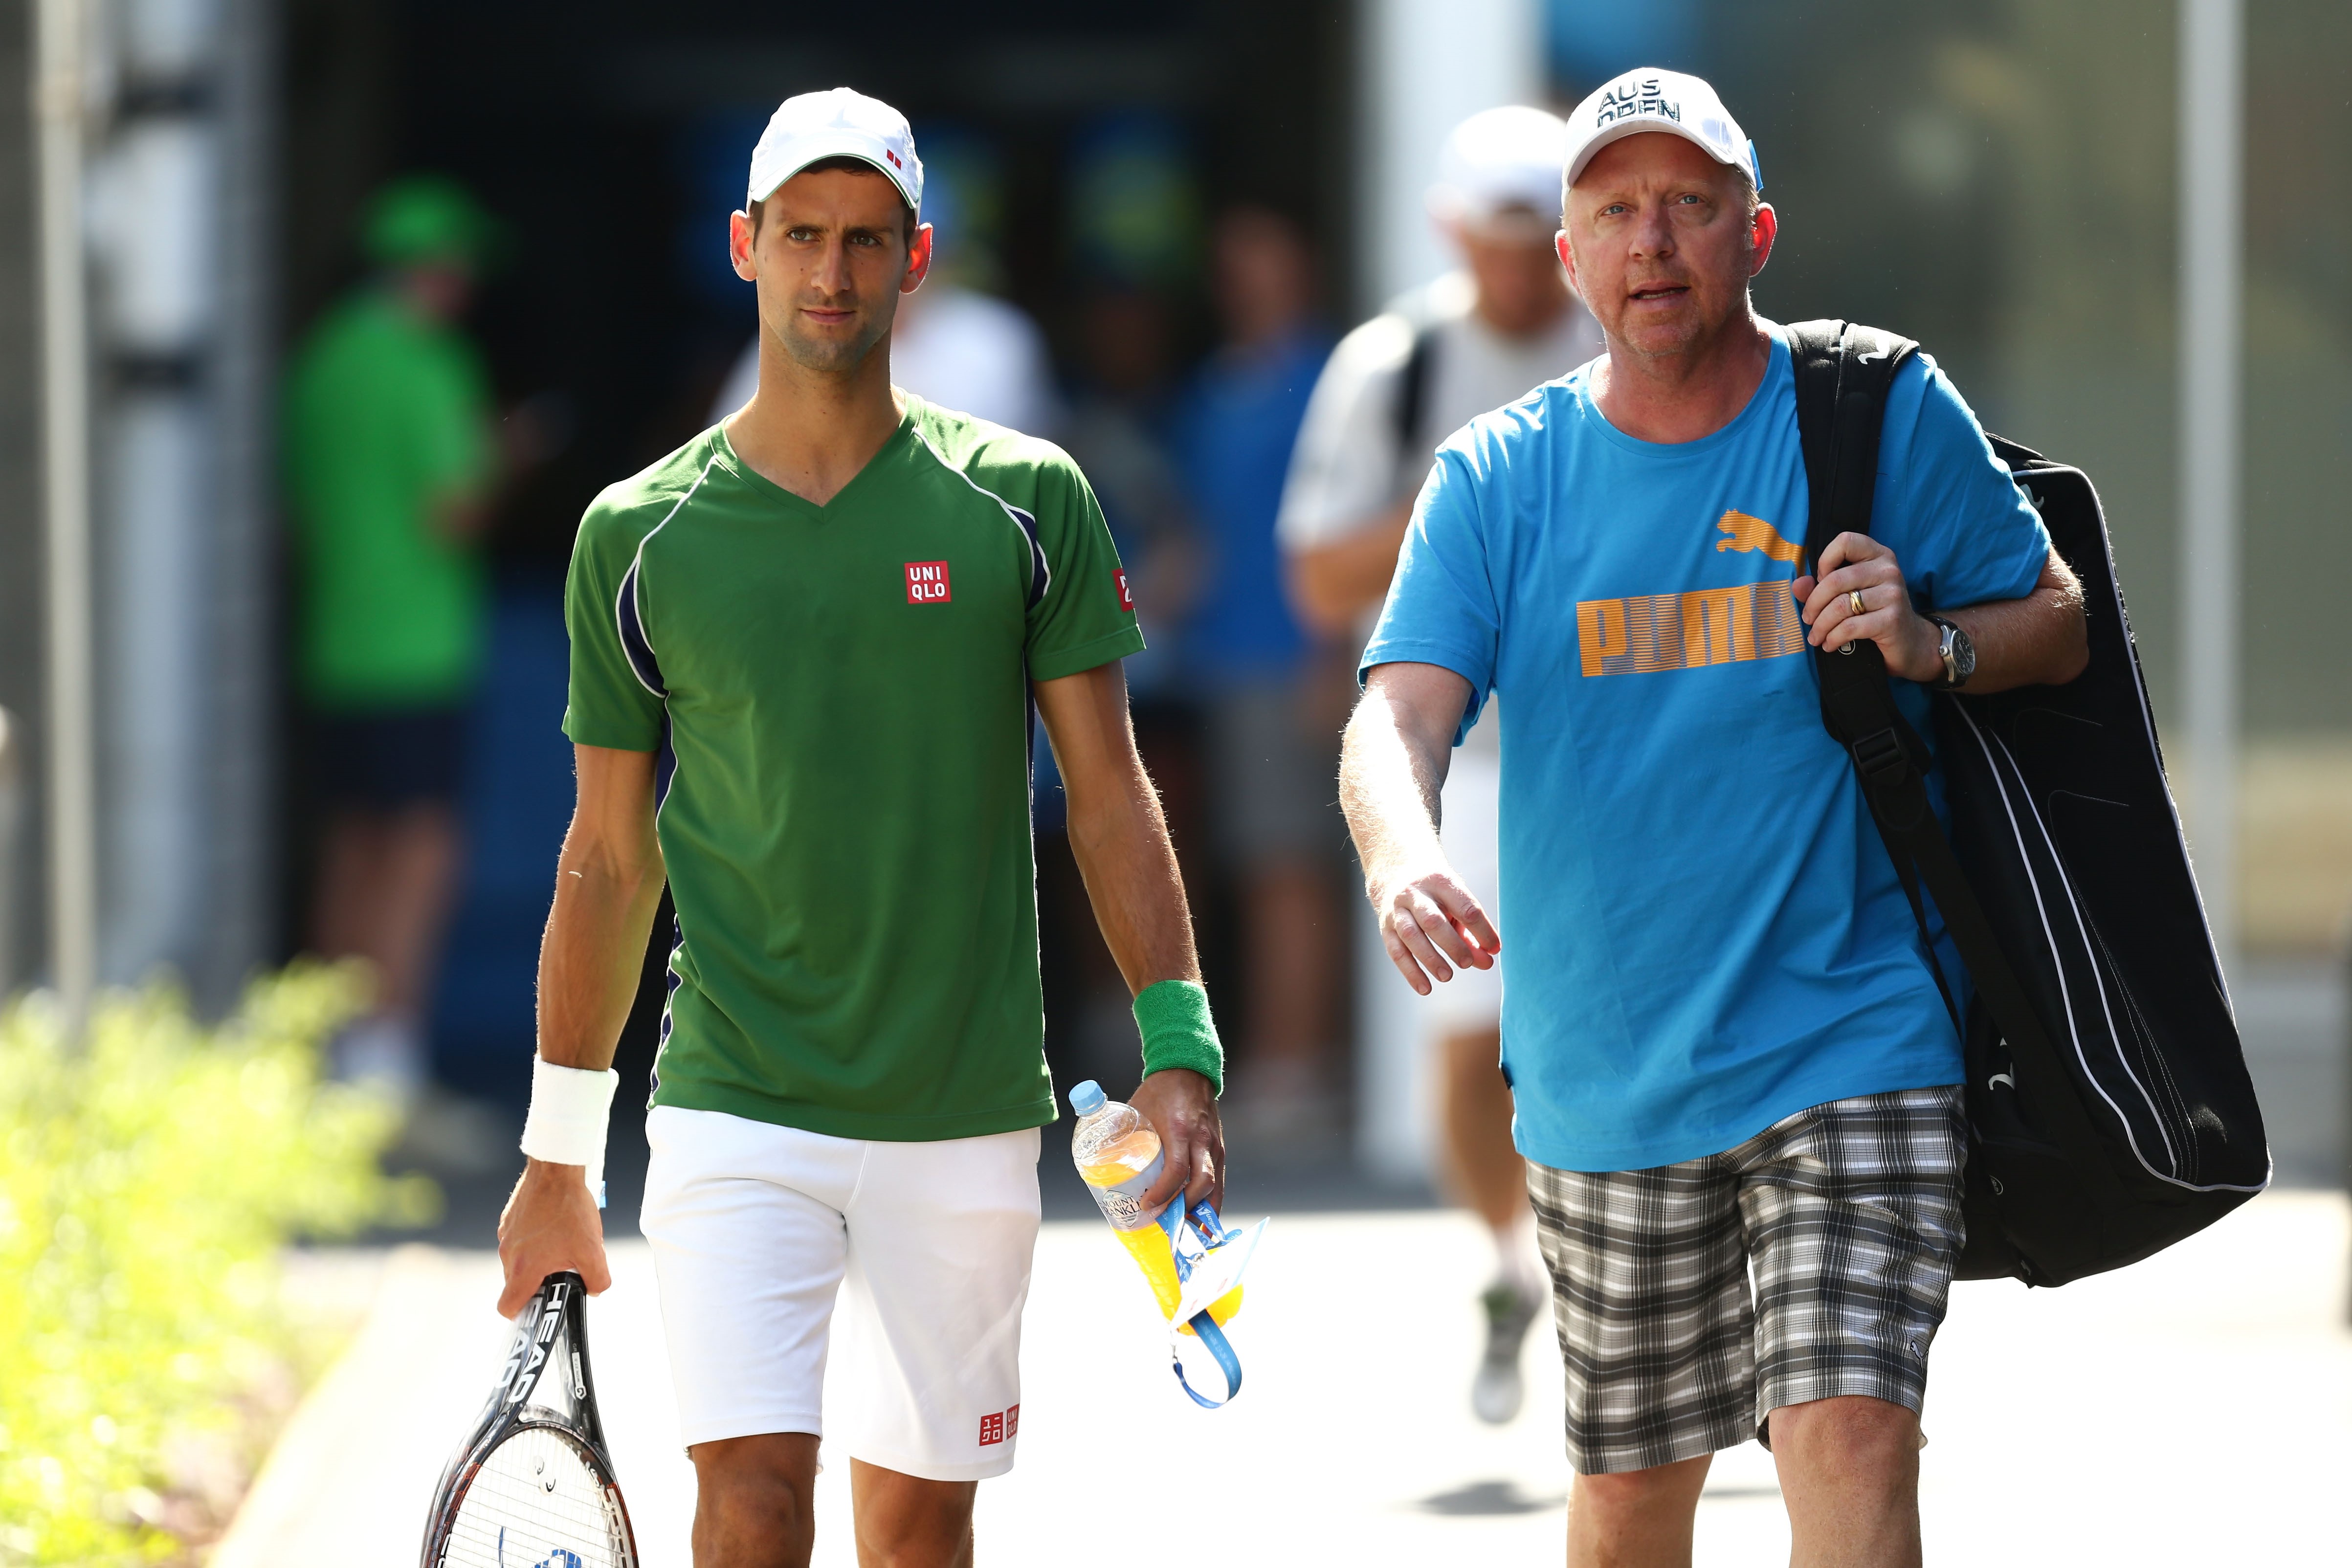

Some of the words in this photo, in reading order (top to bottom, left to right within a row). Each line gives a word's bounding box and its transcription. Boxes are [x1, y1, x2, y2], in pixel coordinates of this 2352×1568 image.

[1598, 79, 1661, 113] AUS
[910, 566, 941, 581] UNI
[911, 583, 946, 601] QLO
[508, 1282, 566, 1403] HEAD
[1008, 1408, 1018, 1422] UNI
[1007, 1420, 1017, 1436] QLO
